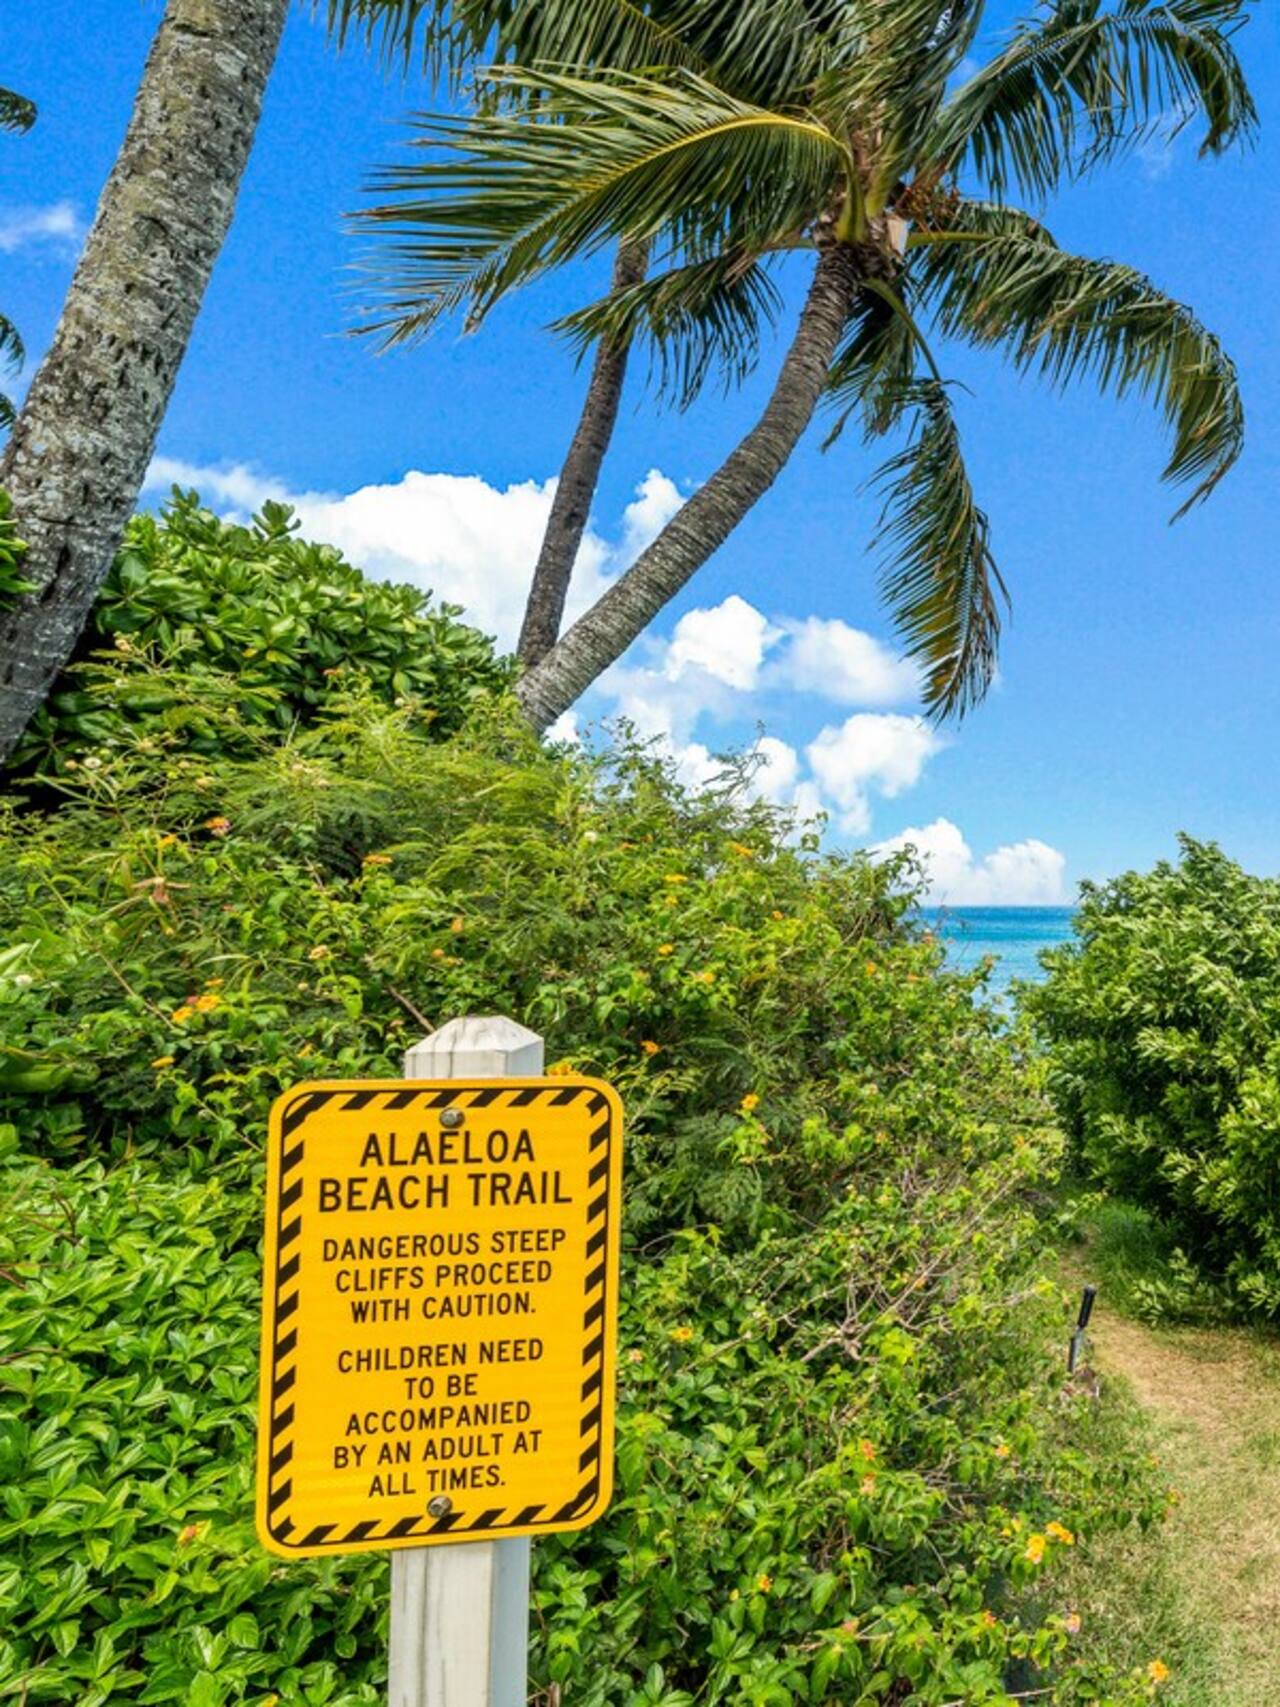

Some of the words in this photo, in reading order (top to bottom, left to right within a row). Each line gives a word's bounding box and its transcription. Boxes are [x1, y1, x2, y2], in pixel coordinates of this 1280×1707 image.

[360, 1129, 534, 1167] ALAELOA
[319, 1174, 448, 1213] BEACH
[467, 1171, 572, 1206] TRAIL
[323, 1233, 479, 1261] DANGEROUS
[491, 1229, 566, 1253] STEEP
[336, 1266, 423, 1293] CLIFFS
[436, 1260, 551, 1287] PROCEED
[351, 1299, 409, 1323] WITH
[422, 1292, 535, 1319] CAUTION.
[338, 1343, 466, 1373] CHILDREN
[480, 1338, 543, 1363] NEED
[405, 1376, 434, 1400] TO
[447, 1374, 477, 1397] BE
[346, 1401, 530, 1436] ACCOMPANIED
[334, 1445, 366, 1468] BY
[378, 1441, 410, 1465] AN
[423, 1433, 503, 1461] ADULT
[513, 1430, 542, 1453] AT
[369, 1473, 415, 1497] ALL
[427, 1465, 505, 1491] TIMES.
